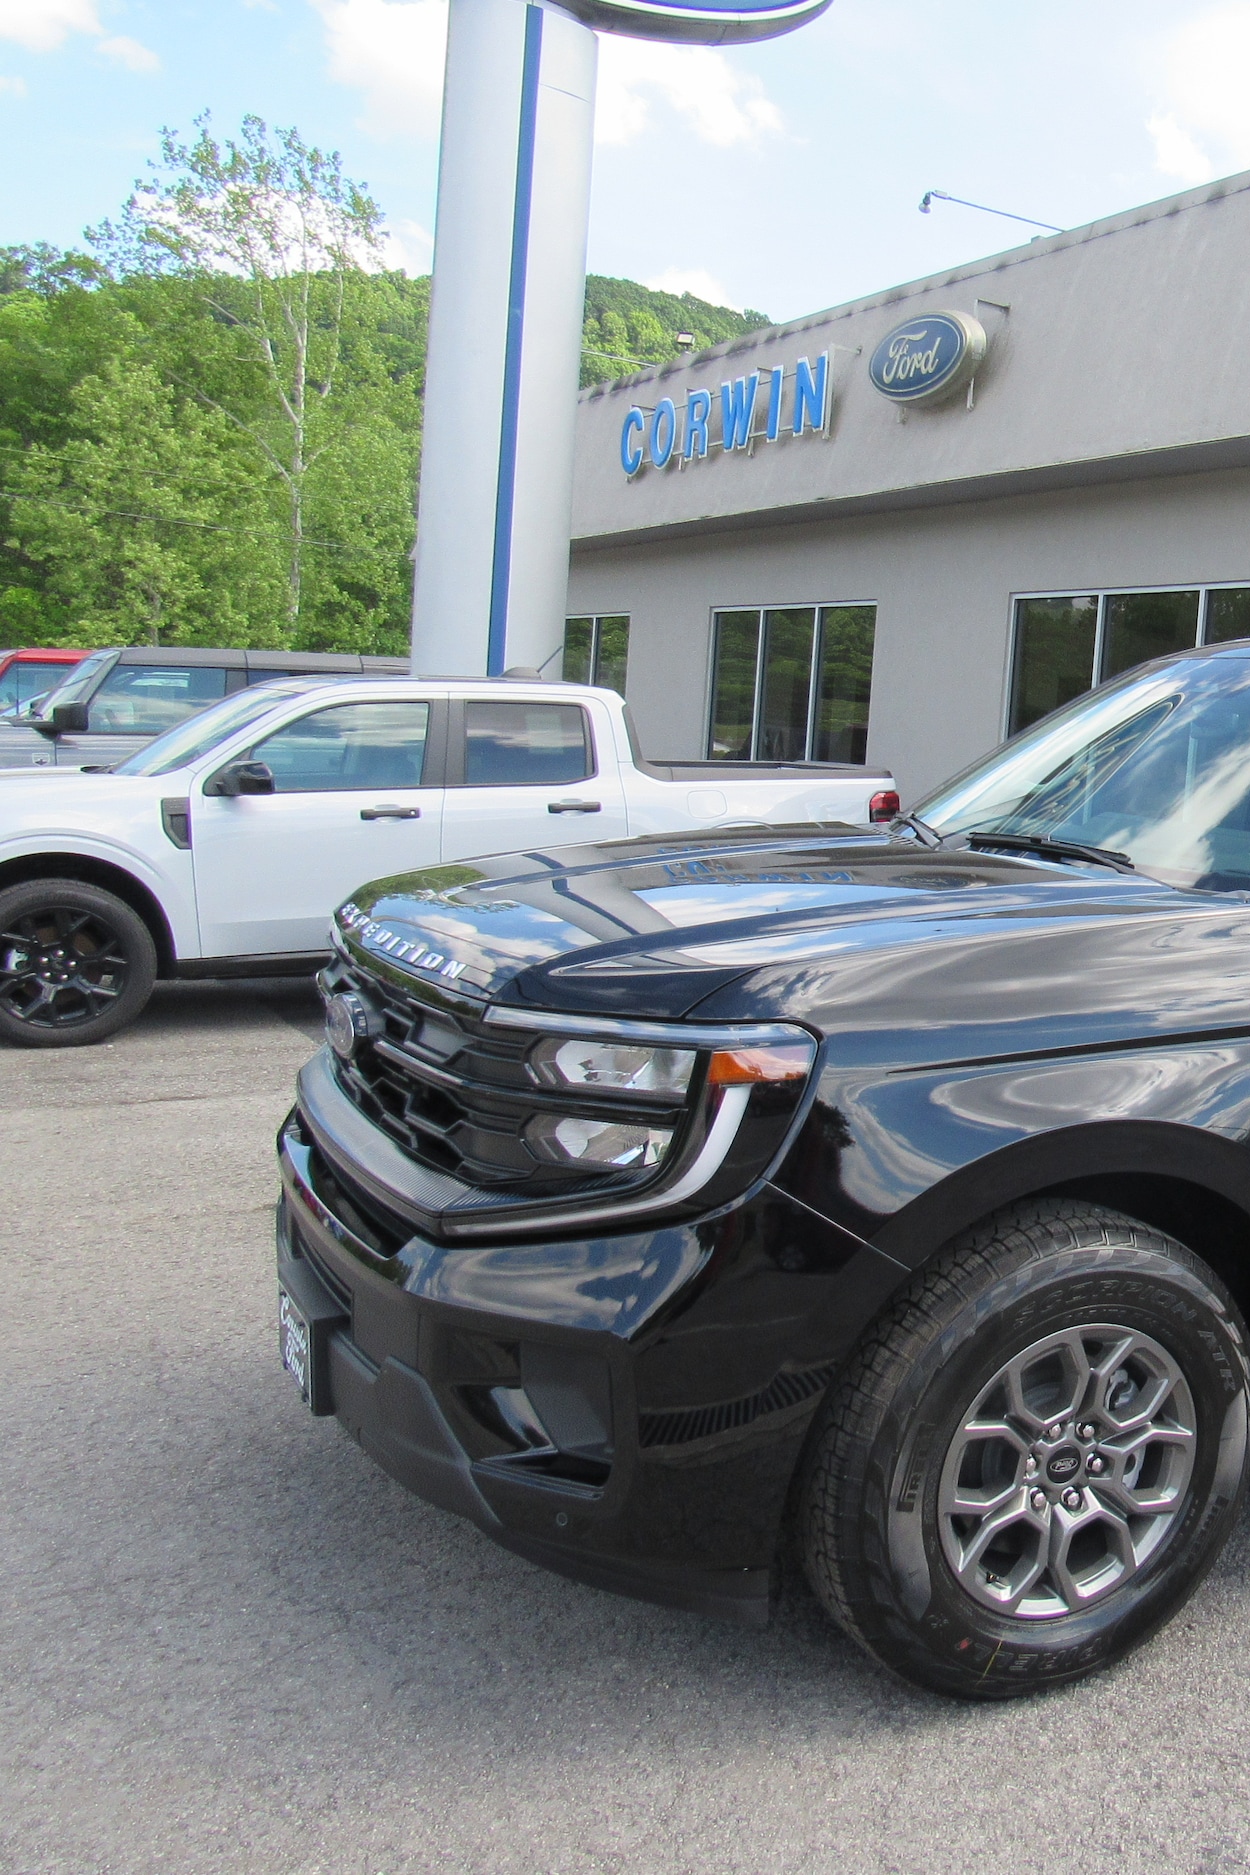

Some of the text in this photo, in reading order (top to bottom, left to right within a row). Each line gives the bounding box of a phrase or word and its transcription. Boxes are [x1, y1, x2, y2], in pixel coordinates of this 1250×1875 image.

[882, 330, 941, 384] Ford
[620, 351, 829, 477] CORWIN
[341, 903, 468, 979] EXPEDITION
[1013, 1279, 1197, 1330] SCORPION
